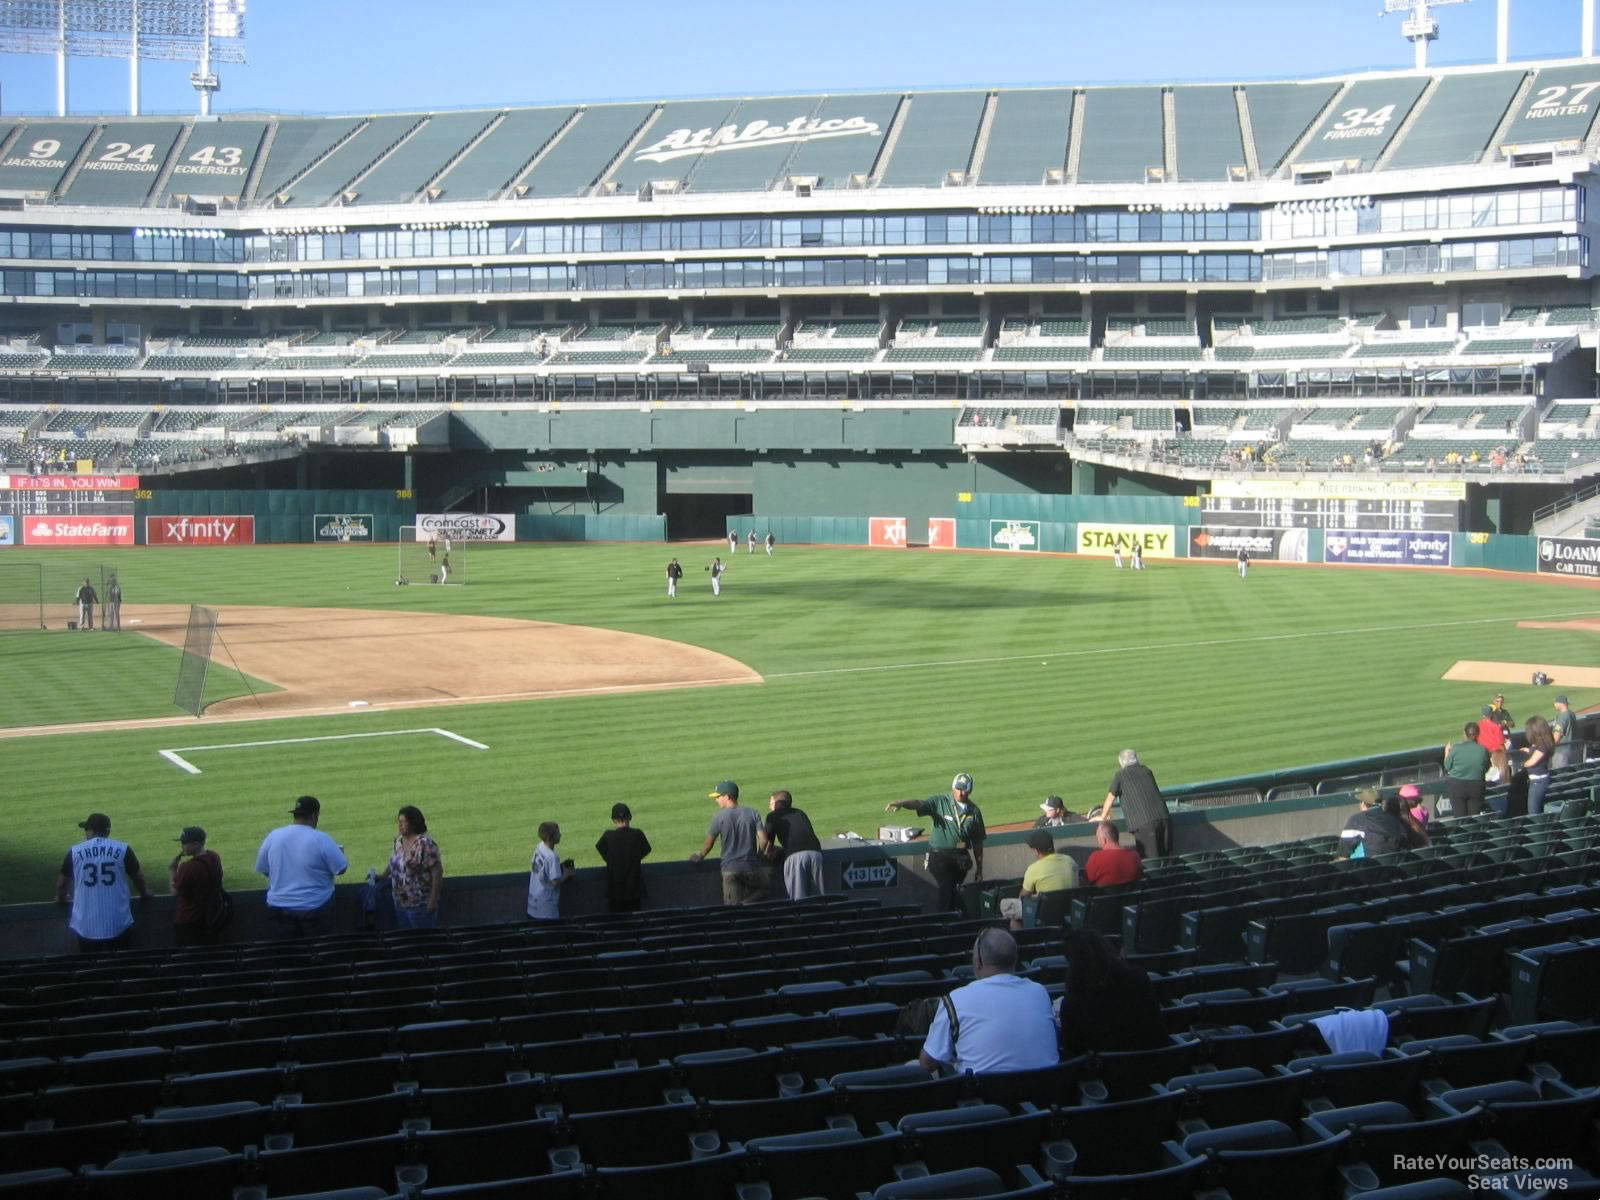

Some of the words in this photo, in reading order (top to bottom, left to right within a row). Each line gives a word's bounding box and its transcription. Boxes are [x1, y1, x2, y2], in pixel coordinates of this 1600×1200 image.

[1530, 83, 1600, 109] 27
[1334, 105, 1396, 130] 34
[1525, 104, 1589, 119] HUNTER
[634, 116, 879, 162] Athletics
[1323, 126, 1385, 141] FINGERS
[29, 139, 61, 159] 9
[99, 142, 156, 162] 24
[188, 146, 243, 166] 43
[3, 158, 68, 168] JACKSON
[84, 161, 159, 172] HENDERSON
[175, 164, 248, 176] ECKERSLEY
[18, 478, 27, 487] IF
[70, 478, 94, 487] YOU
[135, 490, 152, 499] 362
[56, 523, 128, 536] StateFarm
[426, 518, 480, 528] comcast
[167, 522, 236, 541] xfinity
[1409, 538, 1448, 552] xfinity
[1556, 562, 1574, 574] CAR
[1575, 563, 1598, 575] TITLE
[78, 846, 121, 861] THOMAS
[82, 862, 116, 887] 35
[847, 869, 865, 880] 113
[873, 867, 891, 878] 112
